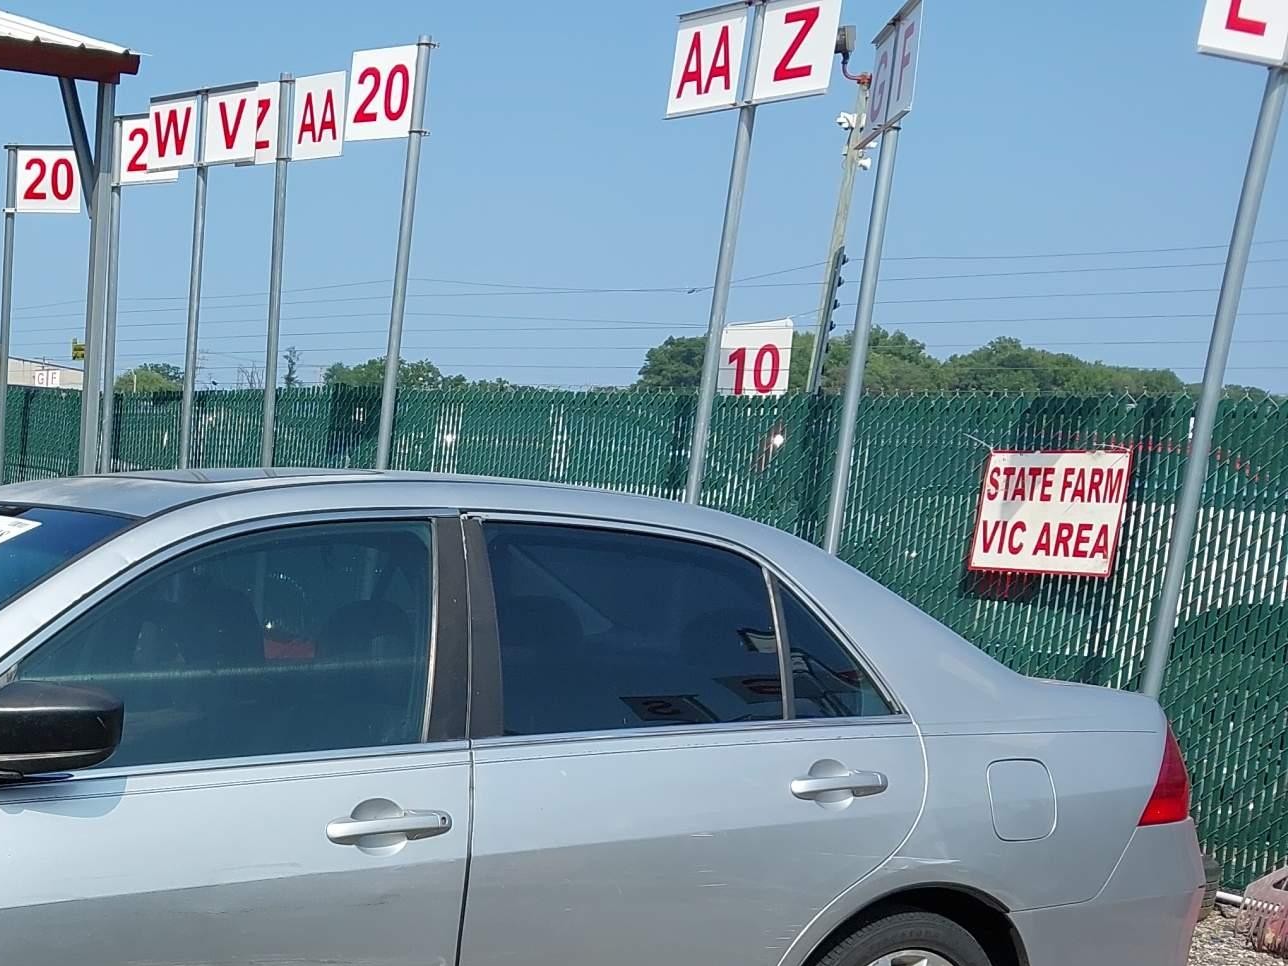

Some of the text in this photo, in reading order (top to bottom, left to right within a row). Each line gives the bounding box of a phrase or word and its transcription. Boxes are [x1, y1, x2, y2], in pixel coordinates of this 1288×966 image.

[675, 25, 731, 99] AA
[773, 6, 820, 82] Z
[297, 89, 337, 144] AA
[353, 63, 410, 124] 20
[127, 127, 149, 172] 2
[154, 106, 192, 158] W
[219, 97, 248, 150] V
[23, 157, 75, 201] 20
[728, 343, 780, 395] 10
[986, 466, 1124, 504] STATE FARM
[981, 519, 1110, 560] VIC AREA
